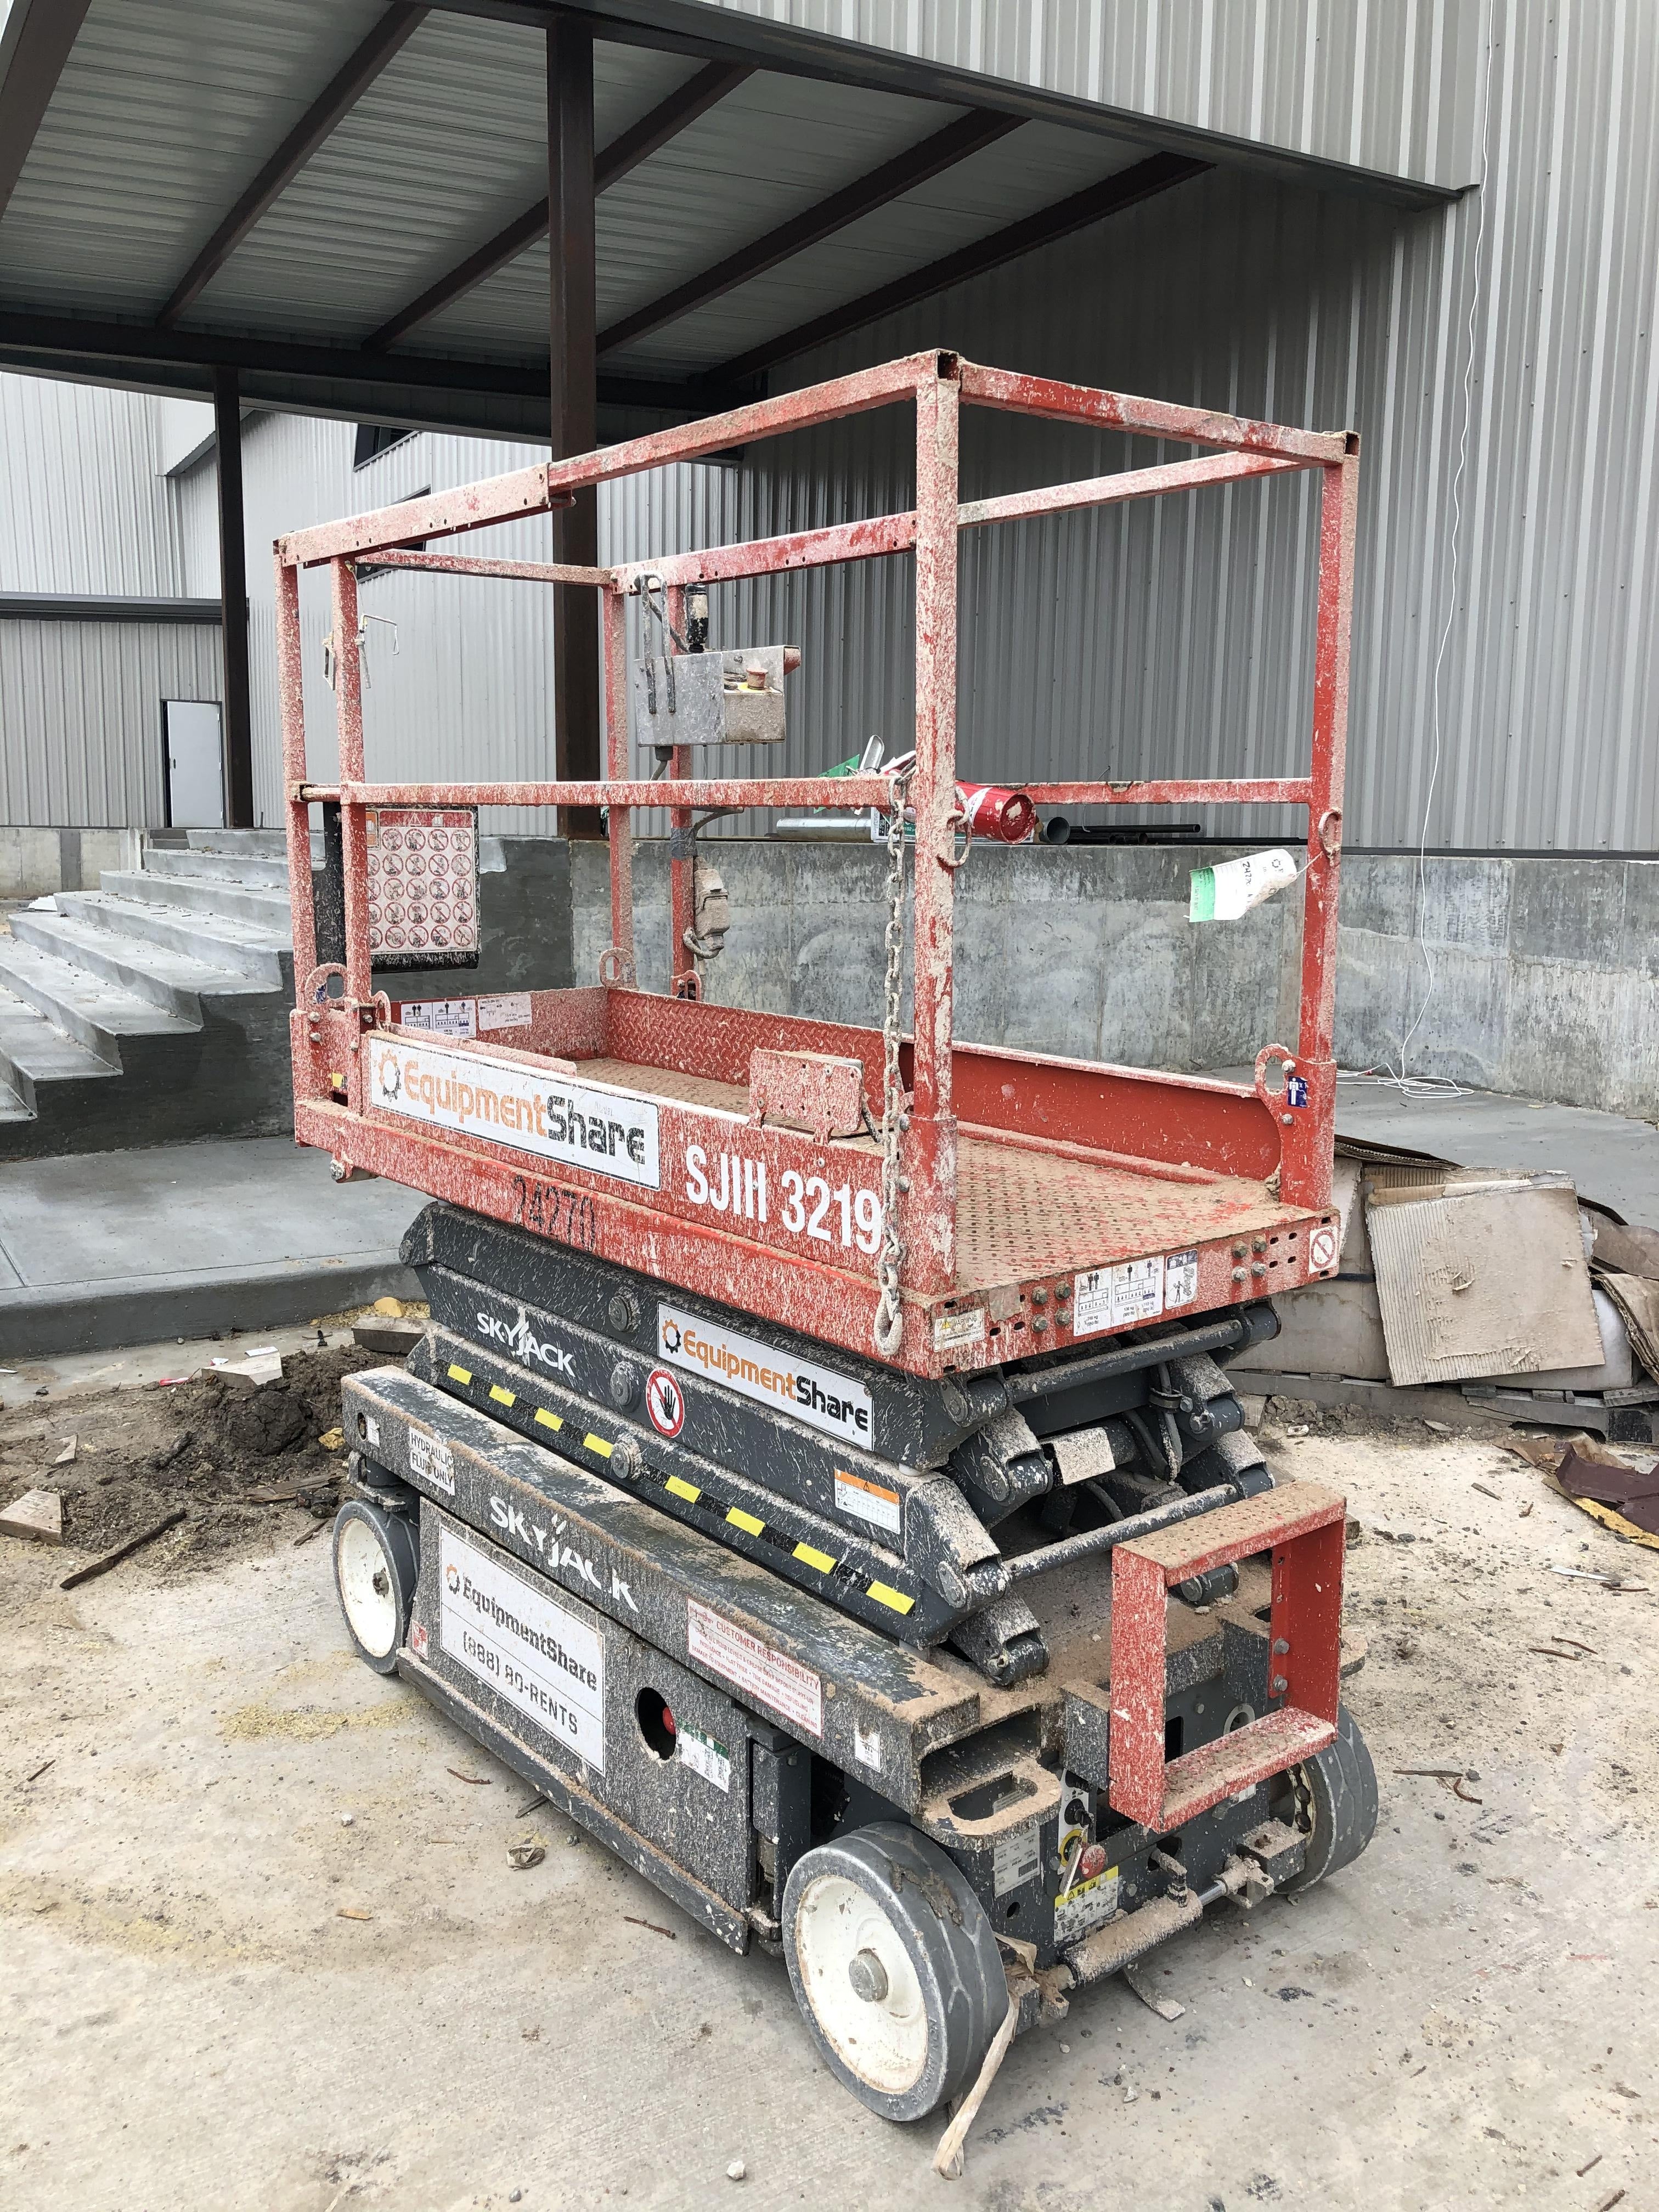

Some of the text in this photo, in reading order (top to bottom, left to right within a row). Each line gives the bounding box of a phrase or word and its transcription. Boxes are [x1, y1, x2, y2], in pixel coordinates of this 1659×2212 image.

[404, 1060, 645, 1165] EquipmentShare
[686, 1144, 882, 1255] SJIII 3219
[477, 1312, 577, 1378] SKYJACK
[684, 1329, 869, 1432] EquipmentShare
[411, 1432, 453, 1467] HYDRAULIC
[433, 1467, 453, 1487] ONLY
[490, 1496, 639, 1613] SKYJACK
[462, 1576, 597, 1691] EquipmentShare
[716, 1621, 819, 1690] CUSTOMER RESPONSIBILITY
